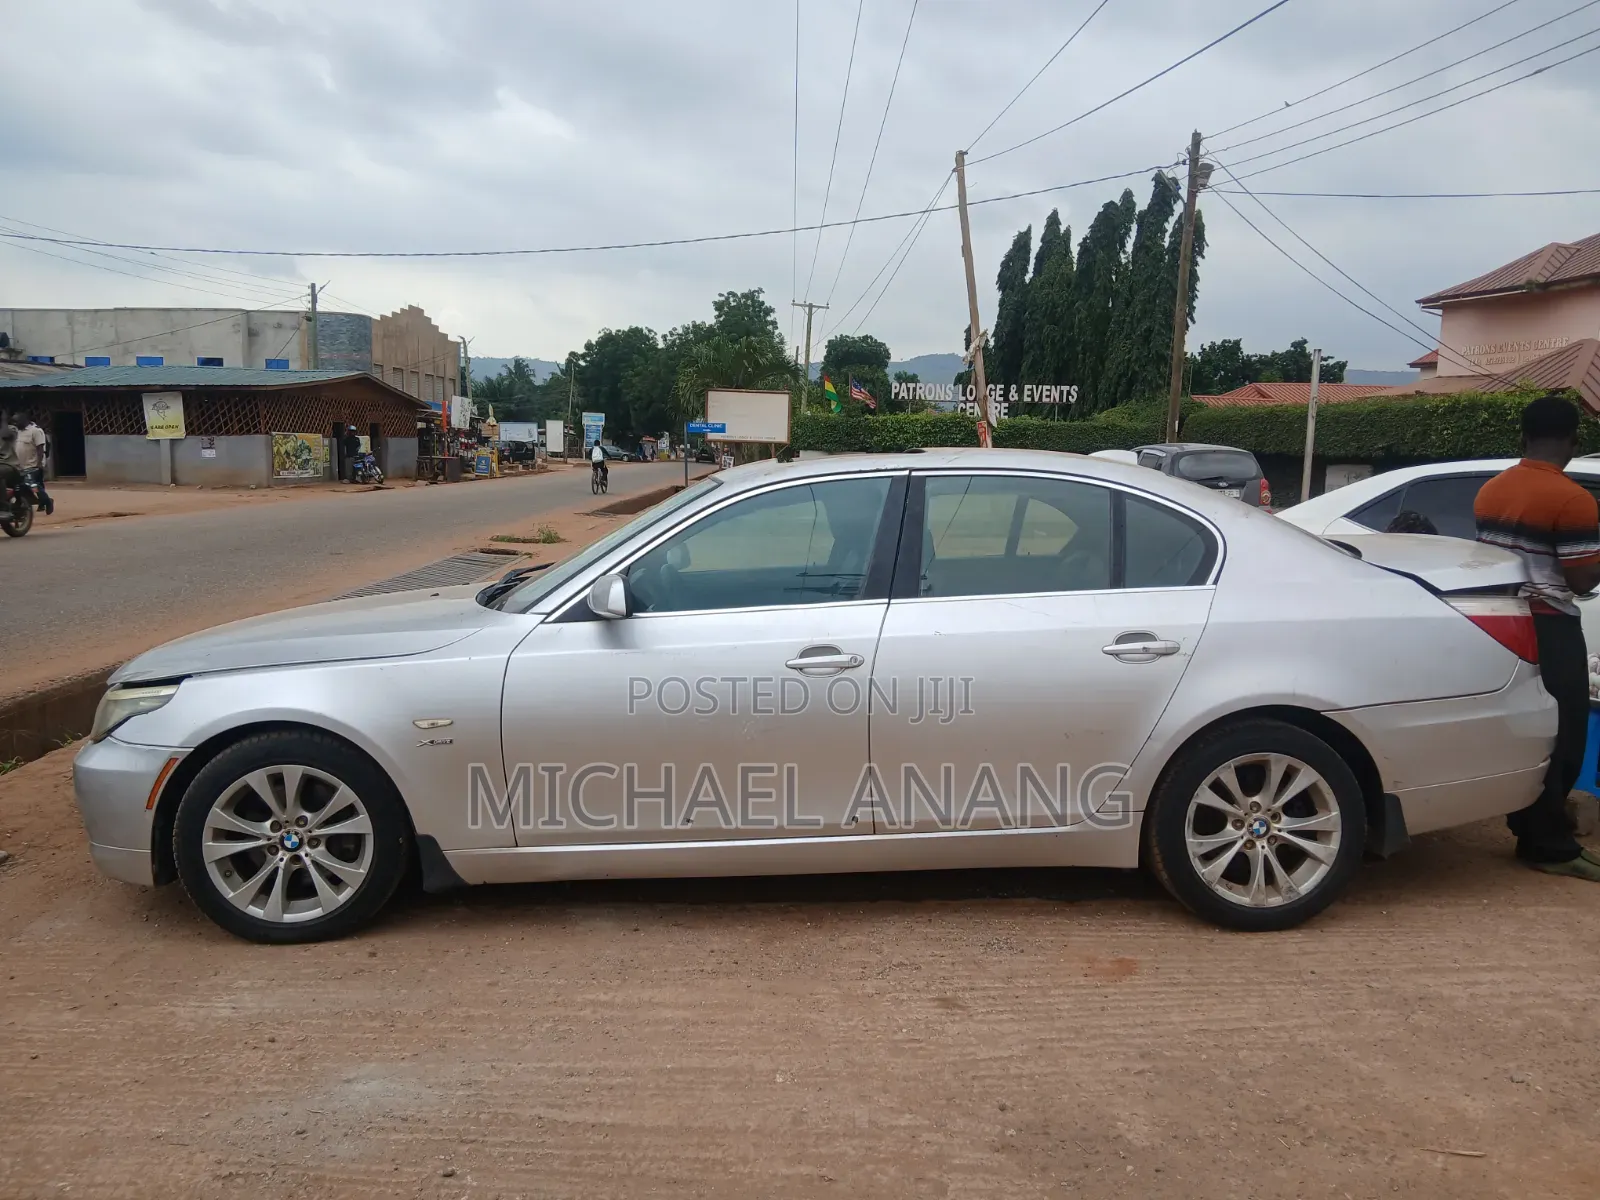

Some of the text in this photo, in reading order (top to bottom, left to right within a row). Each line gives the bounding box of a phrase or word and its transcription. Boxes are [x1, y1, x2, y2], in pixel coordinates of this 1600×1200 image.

[1461, 337, 1569, 356] PATRONS EVENTS CENTRE
[891, 382, 1079, 403] PATRONS LOGE & EVENTS
[957, 402, 1009, 419] CENRE
